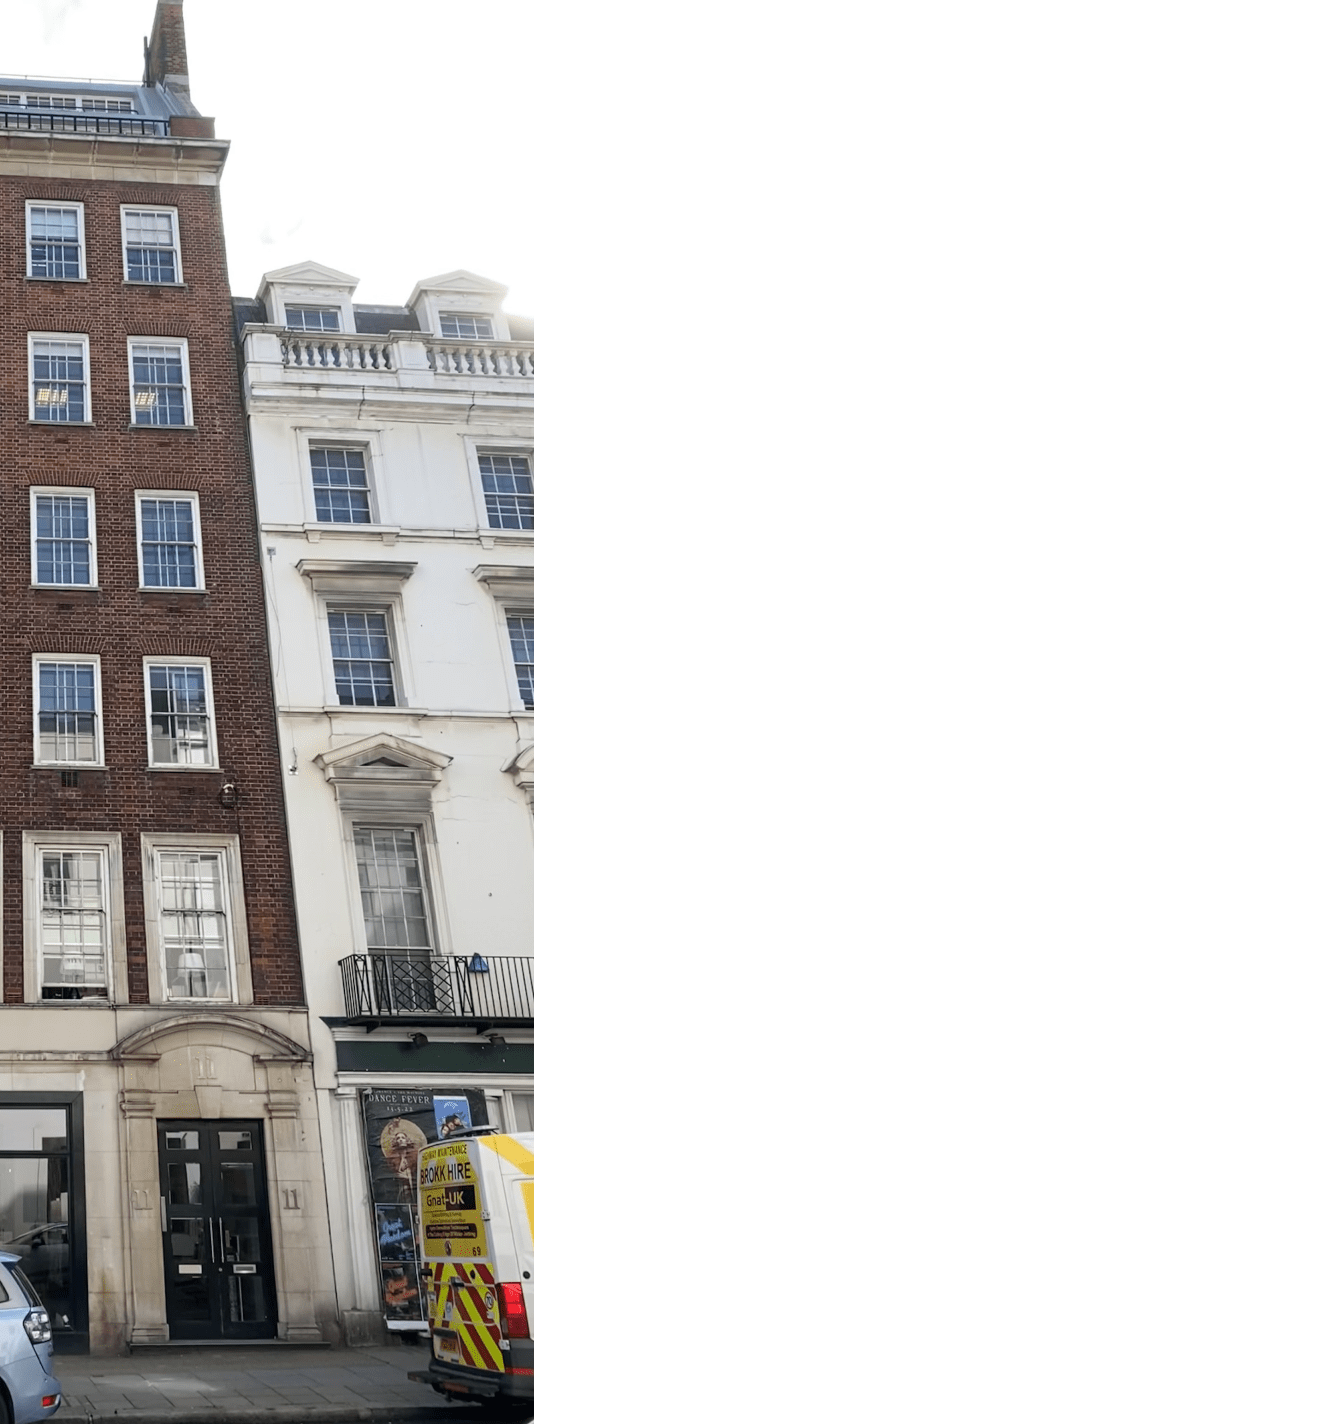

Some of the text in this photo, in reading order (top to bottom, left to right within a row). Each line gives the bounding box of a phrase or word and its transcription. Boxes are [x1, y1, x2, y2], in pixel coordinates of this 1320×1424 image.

[194, 1056, 218, 1079] 11
[368, 1094, 430, 1104] DANCE FEVER
[421, 1162, 471, 1184] BROKK HIRE
[133, 1189, 153, 1210] 11
[282, 1188, 301, 1210] 11
[426, 1191, 465, 1207] Gnat-UK
[472, 1246, 481, 1256] 69
